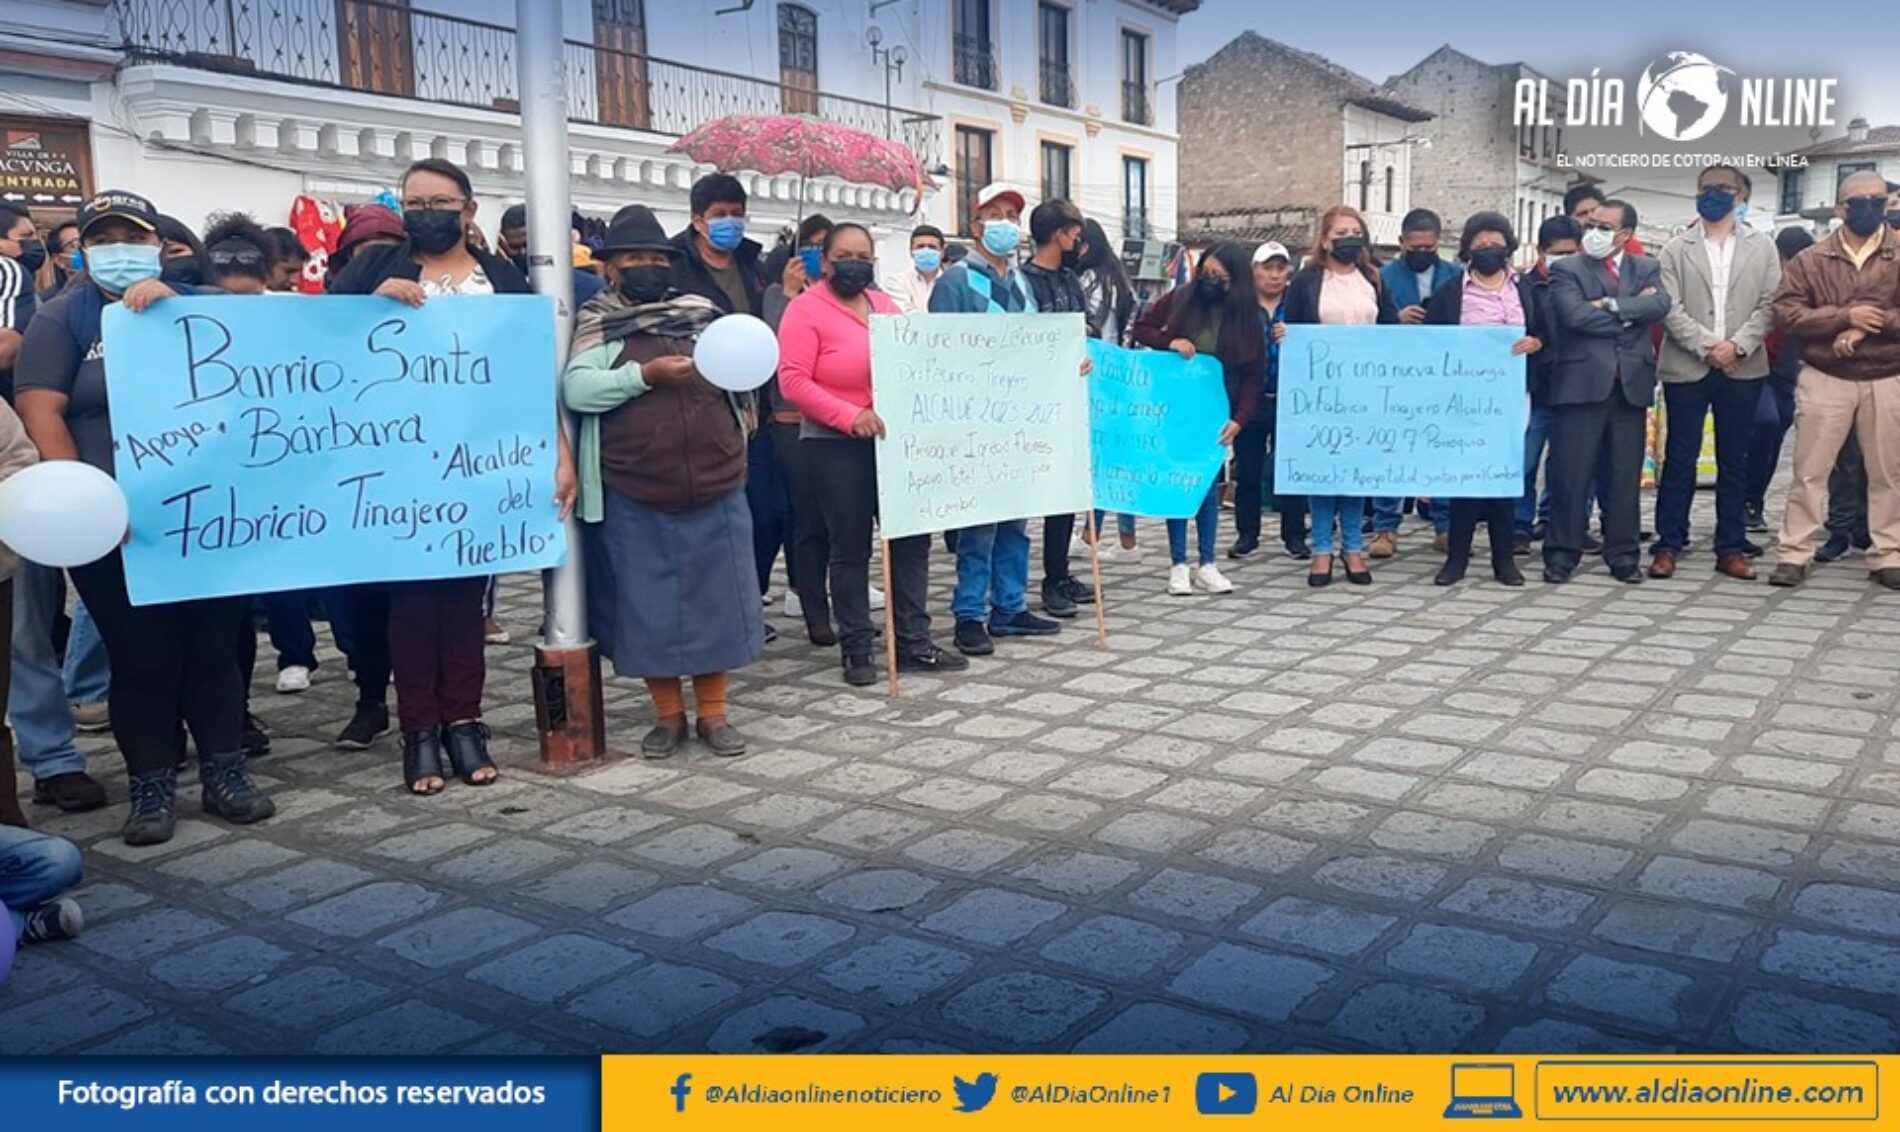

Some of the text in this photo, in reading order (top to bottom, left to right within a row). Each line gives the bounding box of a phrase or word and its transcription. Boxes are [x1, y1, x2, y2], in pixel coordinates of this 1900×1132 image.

[355, 319, 492, 402] Santa
[1306, 338, 1345, 381] Por
[1353, 361, 1387, 379] una
[1392, 364, 1435, 379] nueva
[239, 406, 426, 468] Bárbara
[162, 471, 533, 558] Fabricio Tinajero del
